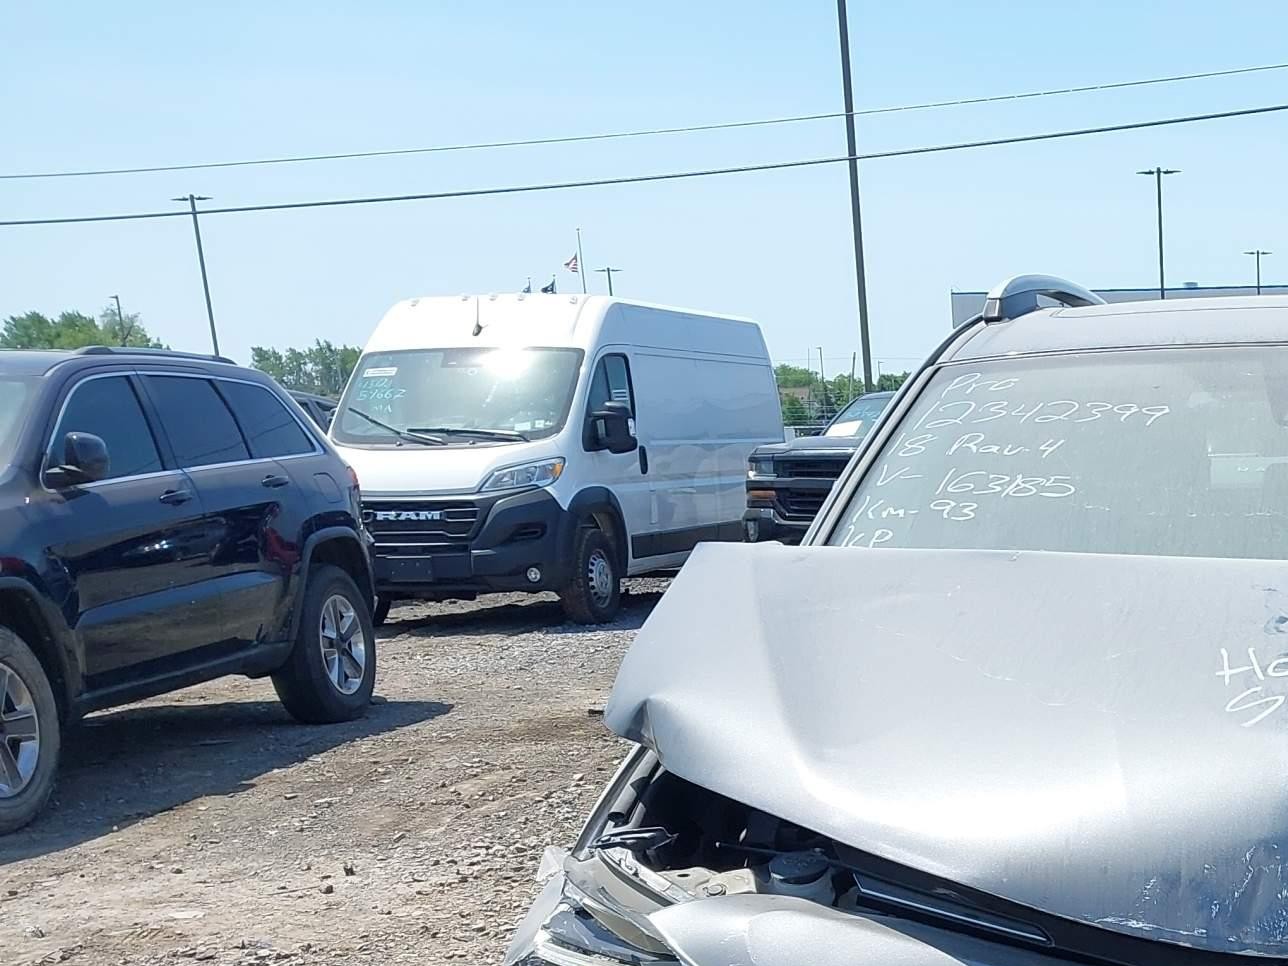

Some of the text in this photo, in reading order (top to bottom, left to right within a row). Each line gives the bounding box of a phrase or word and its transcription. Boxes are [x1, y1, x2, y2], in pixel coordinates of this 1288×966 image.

[912, 400, 1170, 431] 12342399
[886, 432, 938, 457] 18
[935, 467, 1076, 498] 163185
[376, 511, 441, 521] RAM
[929, 499, 978, 521] 93
